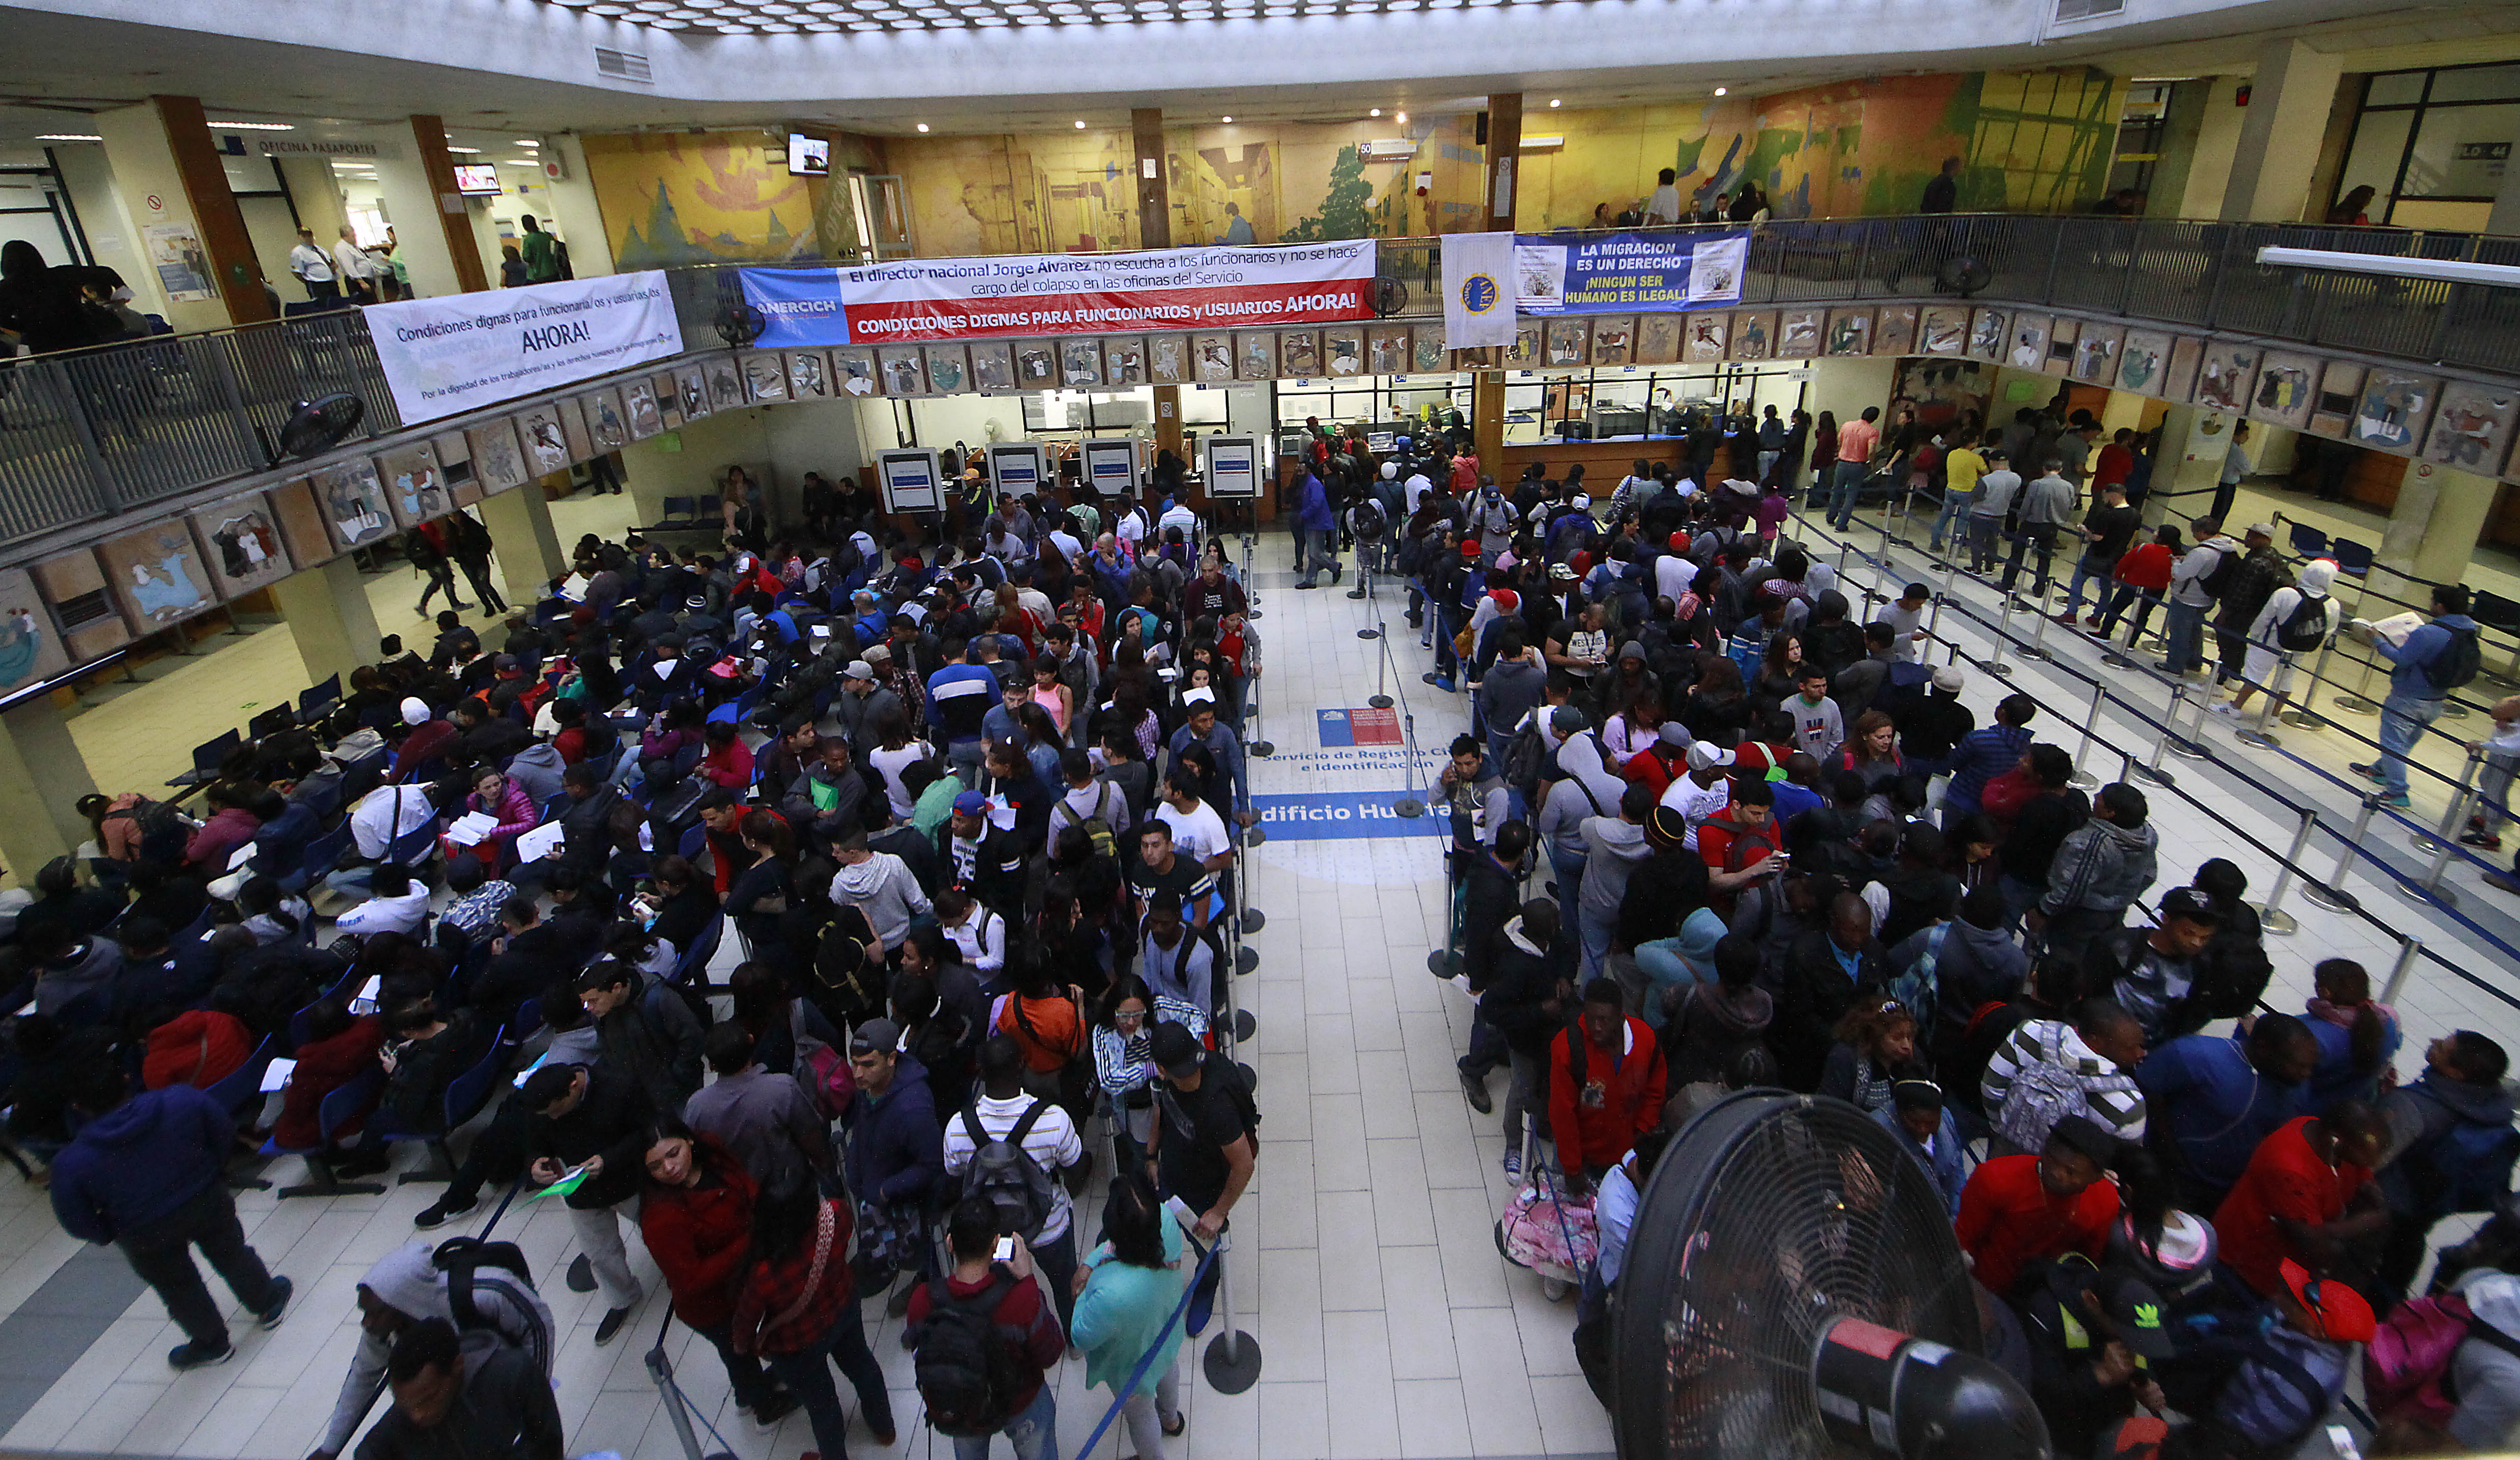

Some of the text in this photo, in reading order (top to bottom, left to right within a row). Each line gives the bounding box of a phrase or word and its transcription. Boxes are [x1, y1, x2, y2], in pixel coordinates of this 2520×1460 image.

[260, 142, 377, 155] OFICINA PASAPORTES
[1361, 144, 1370, 154] 50
[1580, 242, 1676, 257] LA MIGRACION
[850, 246, 1358, 283] El director nacional Jorge Álvarez no escucha a los funcionarios y no se hace
[1576, 256, 1682, 271] ES UN DERECHO
[971, 269, 1243, 297] cargo del colapso en las oficinas del Servicio
[1640, 274, 1663, 287] SER
[1565, 290, 1617, 304] HUMANO
[1620, 289, 1636, 302] ES
[1638, 288, 1686, 301] ILEGAL!
[757, 300, 836, 314] ANERCICH
[857, 292, 1356, 334] CONDICIONES DIGNAS PARA FUNCIONARIOS y USUARIOS AHORA!
[397, 288, 660, 343] Condiciones dignas para funcionaria/os y usuarias/os
[523, 320, 591, 354] AHORA!
[422, 390, 435, 400] Por
[447, 380, 478, 394] dignidad
[480, 378, 489, 386] de
[489, 375, 500, 383] los
[501, 363, 550, 379] trabajadores/as
[556, 359, 565, 367] los
[1263, 752, 1329, 761] Servicio
[1315, 760, 1434, 771] Identificacón
[1261, 804, 1351, 822] dificio
